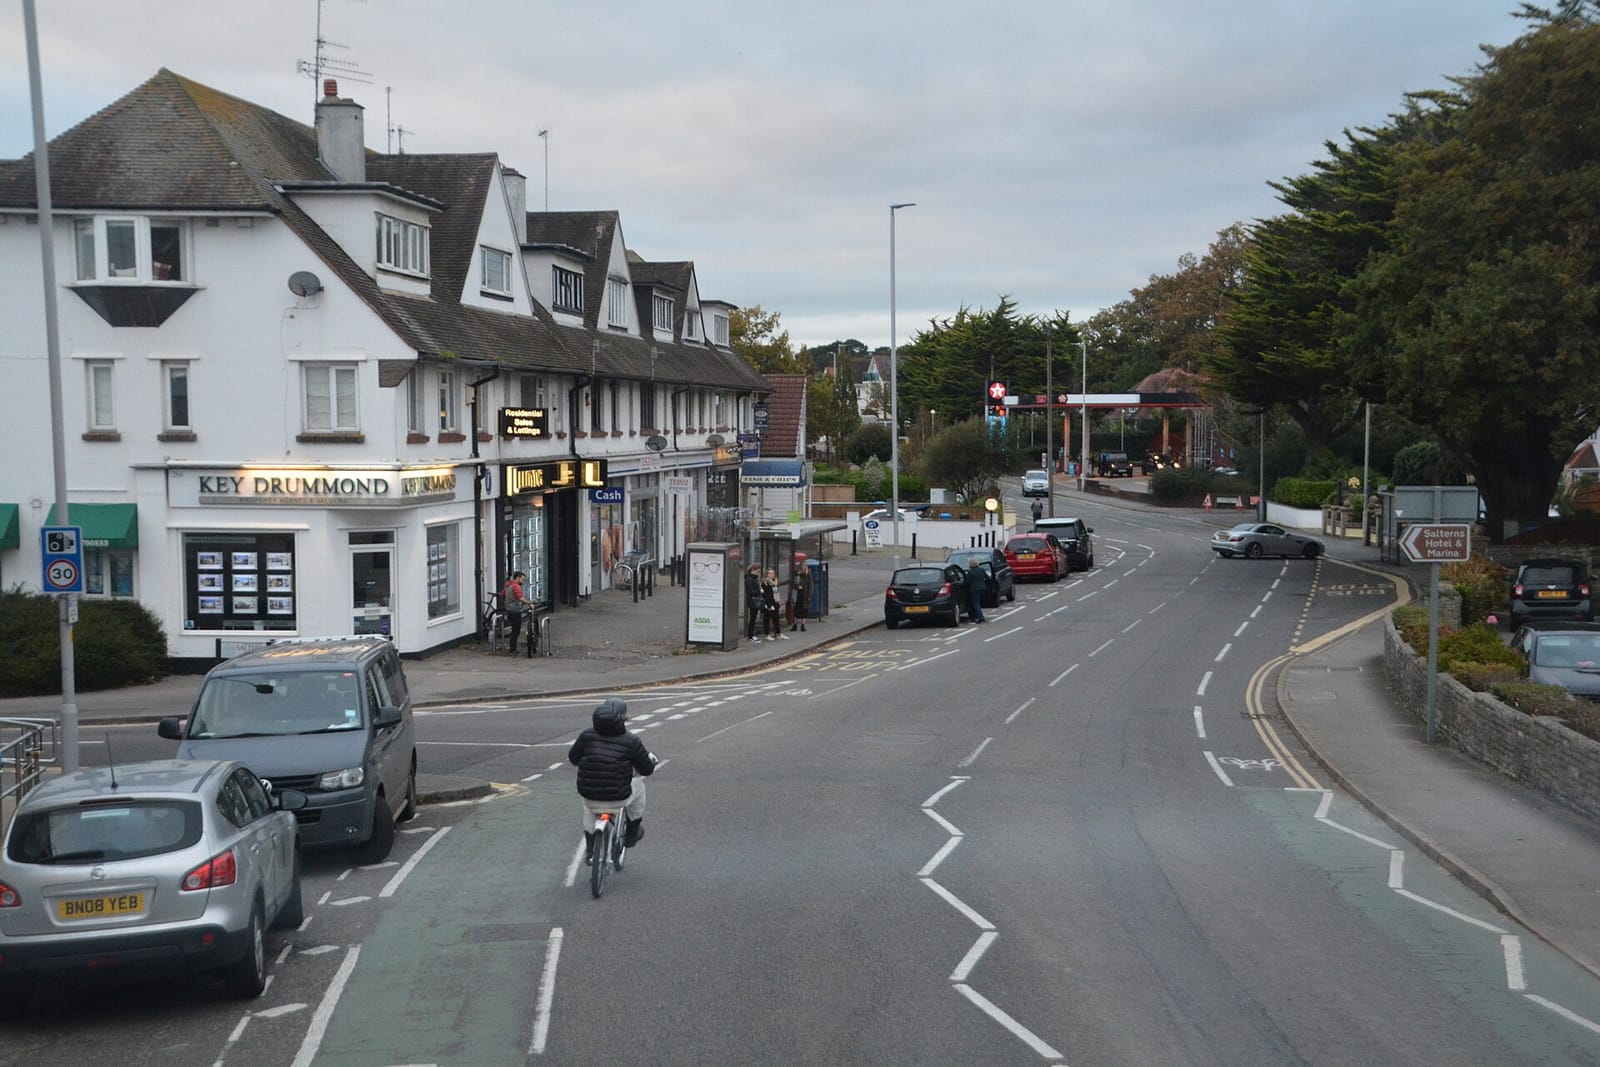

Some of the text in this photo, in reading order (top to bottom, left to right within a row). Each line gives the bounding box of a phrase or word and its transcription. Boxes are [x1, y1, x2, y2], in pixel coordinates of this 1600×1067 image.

[505, 409, 543, 417] Residential
[514, 418, 534, 426] Sales
[507, 426, 541, 435] & Lettings
[199, 476, 389, 495] KEY DRUMMOND
[595, 490, 621, 500] Cash
[1424, 529, 1465, 538] Salterns
[1425, 539, 1452, 547] Hotel
[1427, 549, 1459, 557] Marina
[52, 568, 73, 579] 30
[828, 649, 912, 659] BUS
[786, 661, 899, 671] STOP
[65, 895, 138, 915] BN08 YEB
